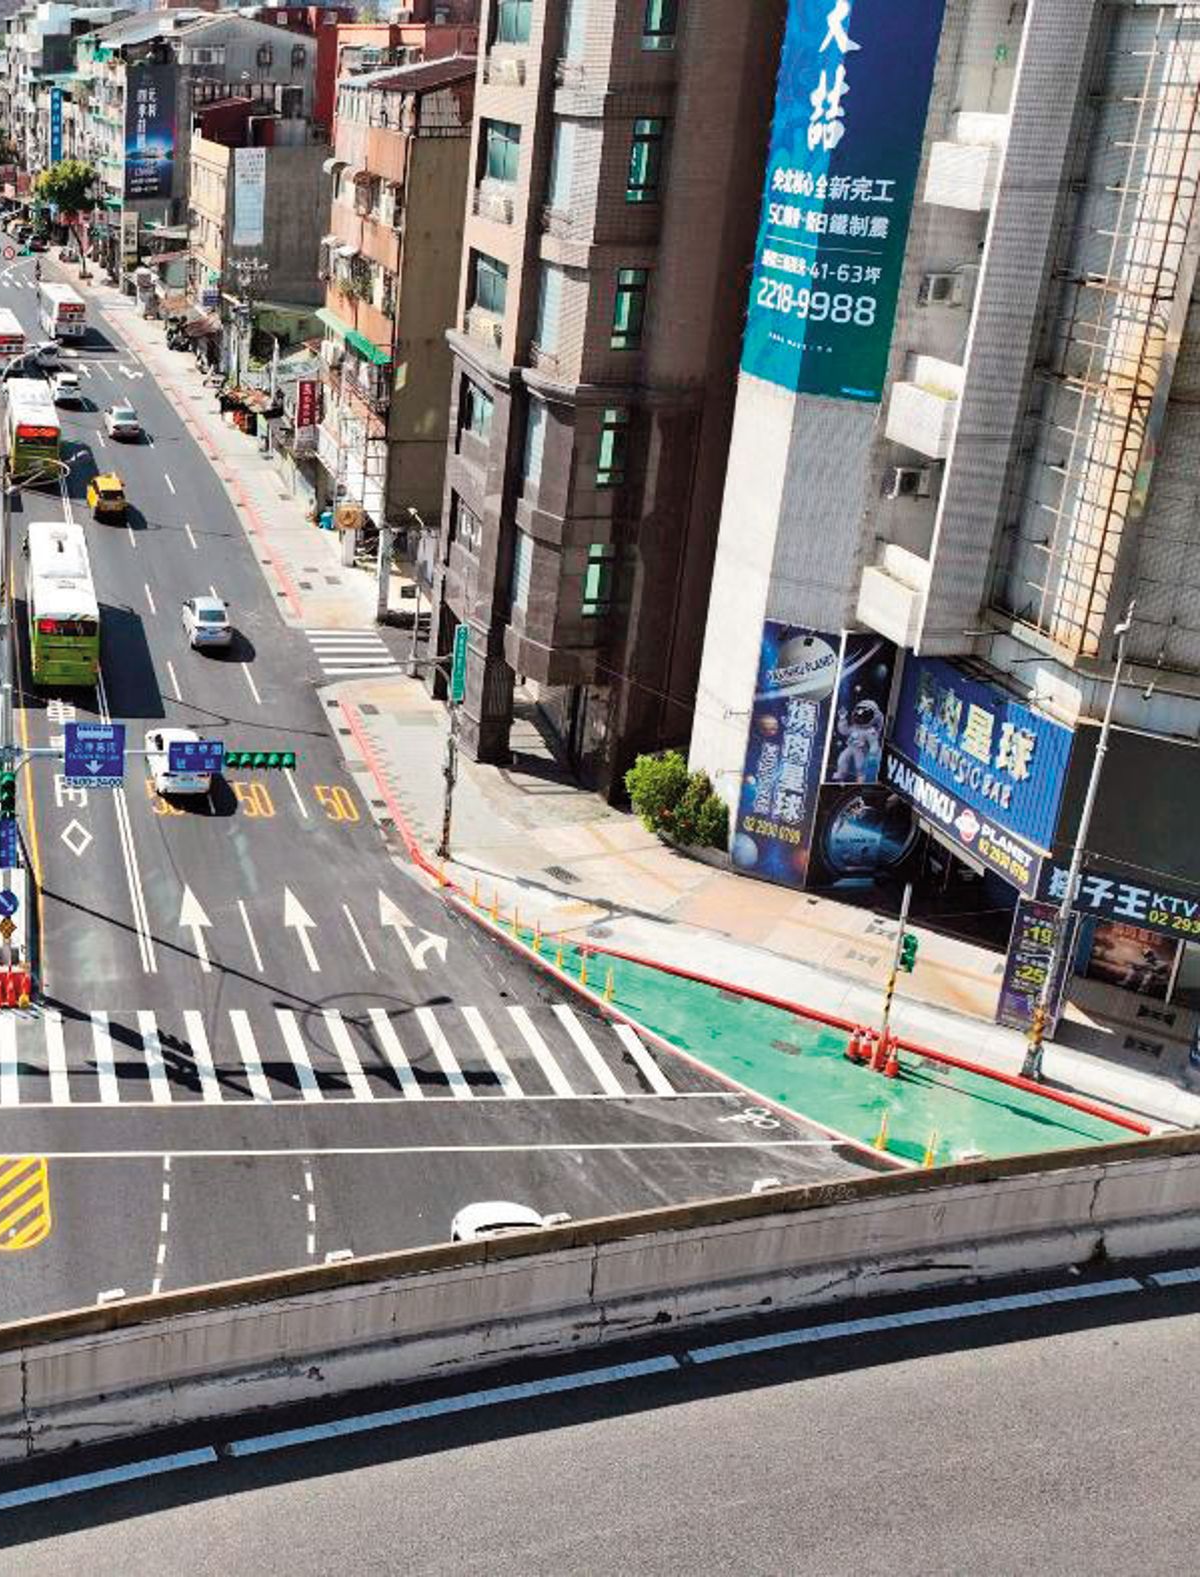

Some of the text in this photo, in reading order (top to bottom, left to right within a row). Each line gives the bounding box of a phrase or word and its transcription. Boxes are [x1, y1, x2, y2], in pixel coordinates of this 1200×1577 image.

[757, 277, 877, 327] 2218-9988
[232, 781, 276, 817] 50
[314, 785, 360, 821] 50
[887, 754, 1033, 868] YAKINIKU PLANET
[1149, 910, 1169, 925] 02
[1151, 893, 1199, 917] KTV
